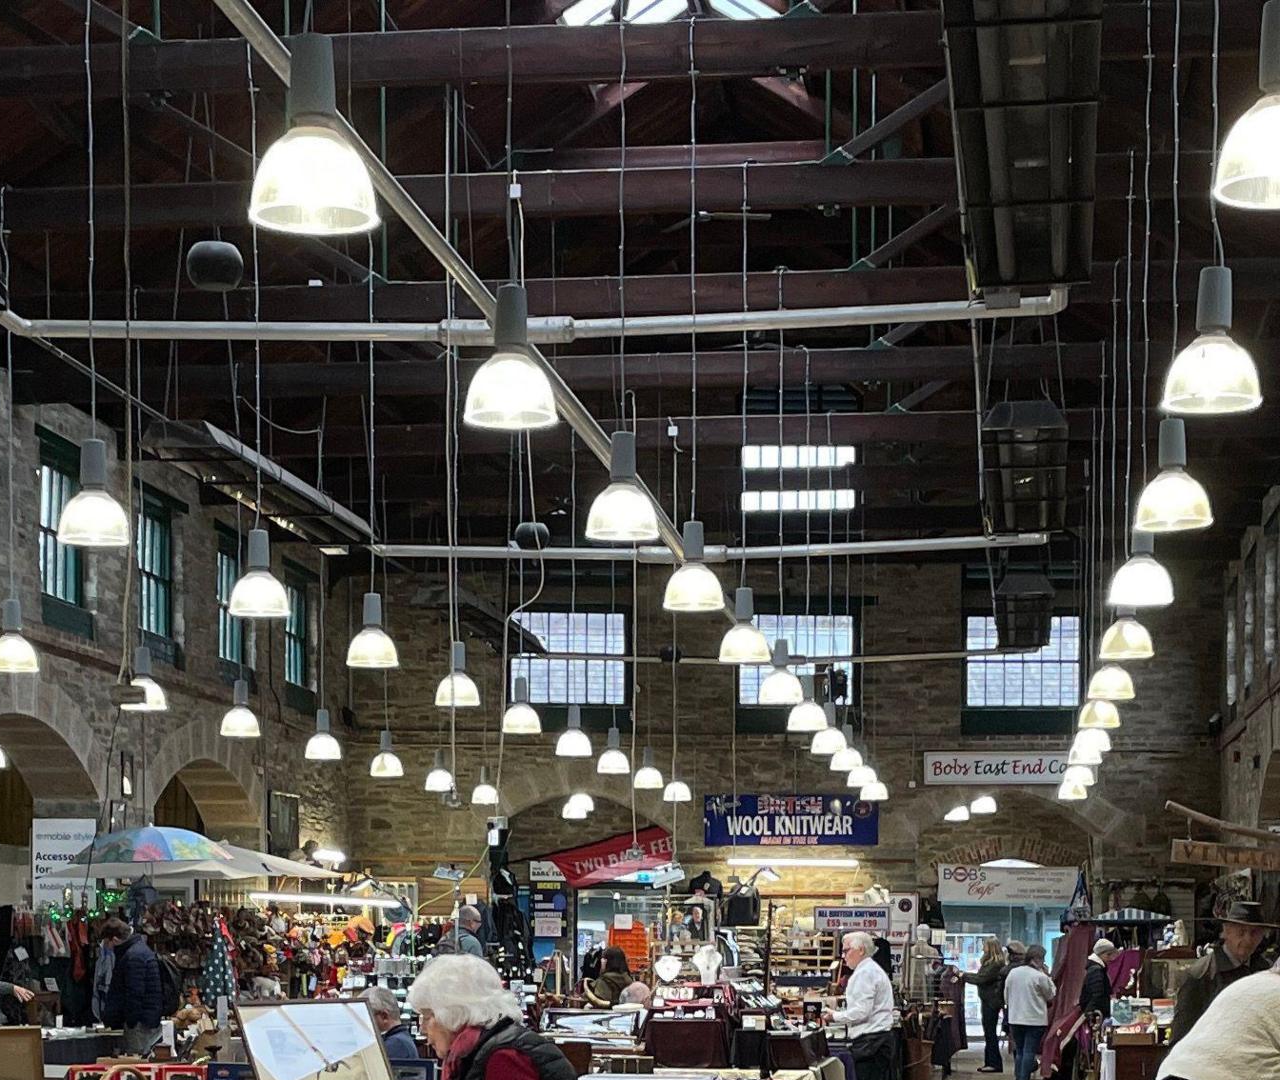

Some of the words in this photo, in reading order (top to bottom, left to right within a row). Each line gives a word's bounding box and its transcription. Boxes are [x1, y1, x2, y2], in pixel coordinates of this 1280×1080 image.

[932, 759, 970, 776] Bobs
[974, 760, 1010, 775] East
[1012, 759, 1046, 775] End
[727, 815, 771, 836] WOOL
[775, 814, 853, 836] KNITWEAR
[574, 856, 605, 875] TWO
